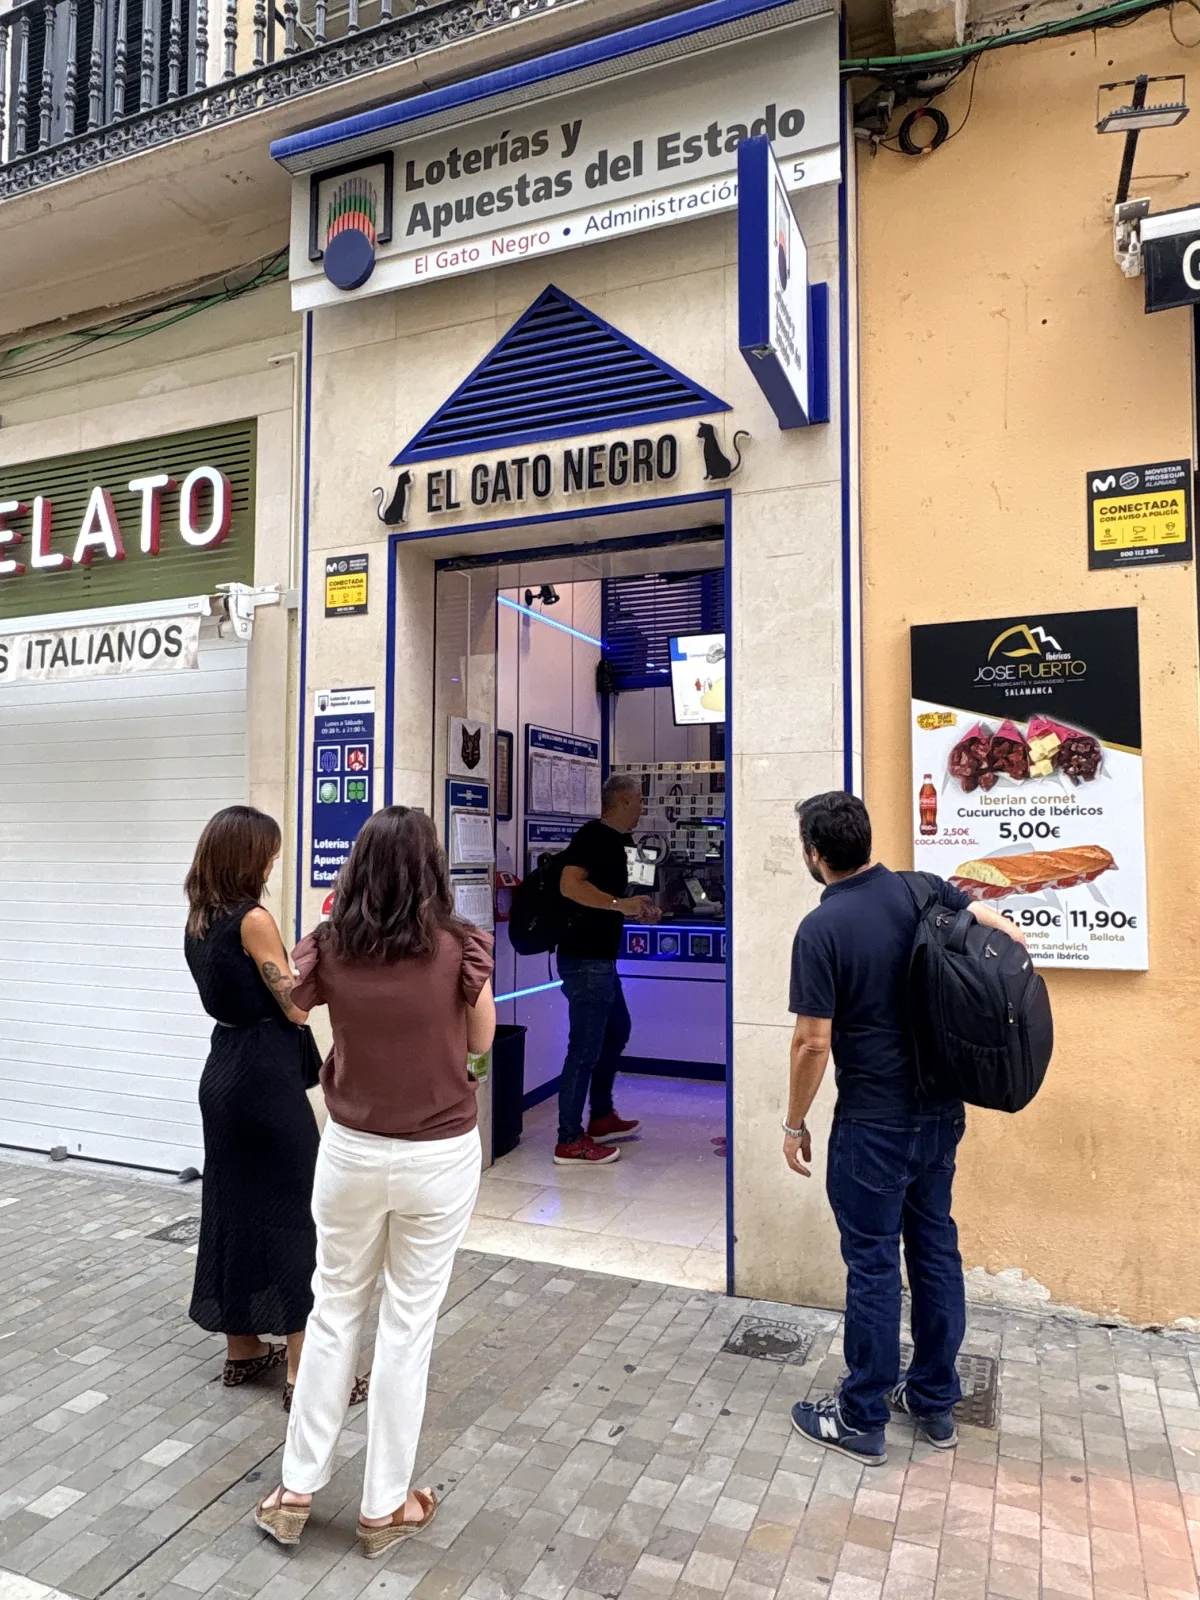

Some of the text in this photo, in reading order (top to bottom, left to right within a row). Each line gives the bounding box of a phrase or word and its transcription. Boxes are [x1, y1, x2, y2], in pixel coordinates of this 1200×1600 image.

[405, 118, 584, 192] Loterías y
[405, 103, 806, 238] Apuestas del Estado
[413, 256, 430, 275] El
[435, 247, 480, 270] Gato
[491, 229, 552, 258] Negro
[792, 161, 806, 182] 5
[426, 433, 678, 514] EL GATO NEGRO
[1144, 465, 1182, 476] MOVISTAR
[1144, 471, 1185, 482] PROSEGUR
[1145, 478, 1177, 488] ALARMAS
[1099, 498, 1179, 516] CONECTADA
[1117, 512, 1141, 522] AVISO
[1148, 508, 1179, 518] POLICÍA
[26, 624, 183, 670] ITALIANOS
[1045, 651, 1071, 661] Ibéricos
[973, 660, 1087, 682] JOSE PUERTO
[1004, 686, 1053, 697] SALAMANCA
[979, 793, 1077, 806] Iberian cornet
[957, 805, 1104, 818] Cucurucho de Ibéricos
[942, 827, 970, 838] 2,50€
[999, 821, 1061, 842] 5,00€
[313, 837, 350, 849] Loterías
[914, 838, 960, 846] COCA-COLA
[313, 870, 338, 881] Estad
[1069, 910, 1138, 932] 11,90€
[1089, 933, 1125, 942] Bellota
[1041, 942, 1088, 952] sandwich
[1030, 952, 1054, 960] amón
